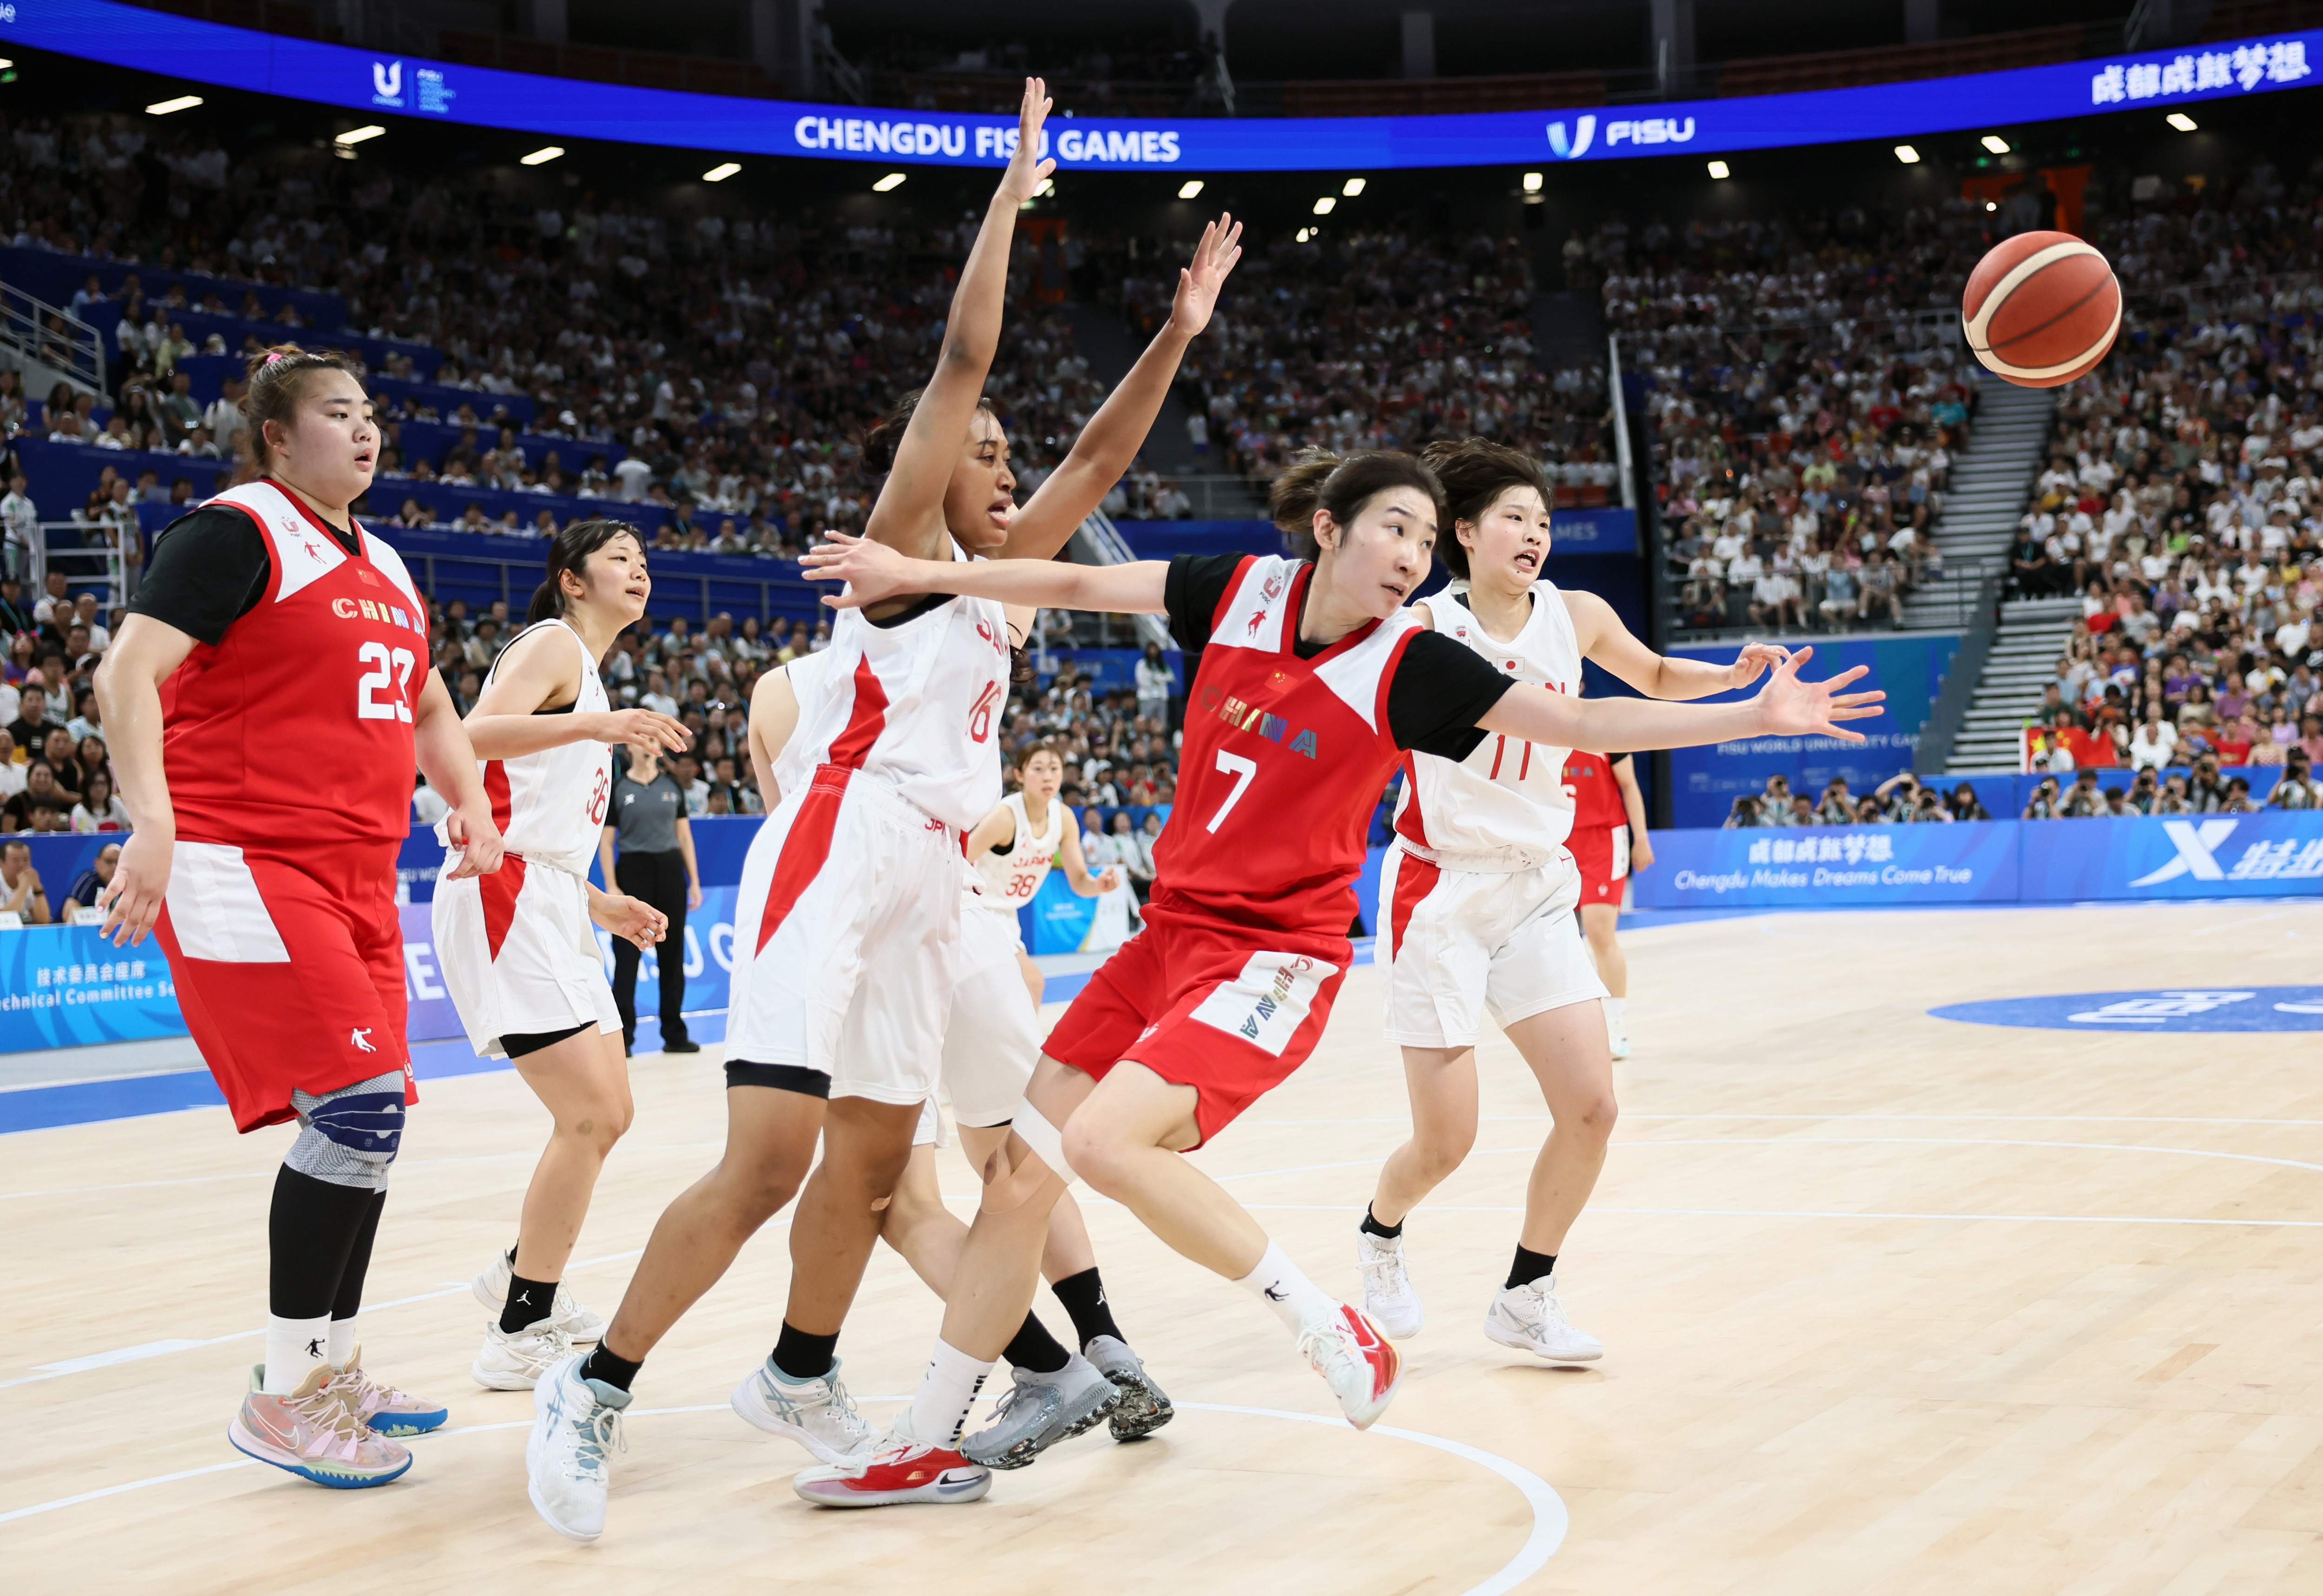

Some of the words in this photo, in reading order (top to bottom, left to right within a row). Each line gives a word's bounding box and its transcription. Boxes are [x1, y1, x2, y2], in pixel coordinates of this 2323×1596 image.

[794, 116, 966, 157] CHENGDU
[1057, 130, 1181, 162] GAMES
[1606, 117, 1695, 146] FISU
[332, 598, 426, 639] CHINA
[1259, 591, 1271, 604] FUSC
[358, 641, 415, 723] 23
[966, 680, 1001, 744] 16
[1201, 684, 1317, 759] CHINA
[1490, 734, 1531, 781] 11
[1750, 738, 1803, 754] WORLD
[586, 767, 608, 825] 36
[1206, 749, 1257, 834] 7
[1006, 874, 1037, 897] 38
[1674, 869, 1749, 894] Chengdu
[1751, 868, 1809, 889] Makes
[1813, 867, 1879, 887] Dreams
[1881, 865, 1933, 885] Come
[1933, 865, 1973, 884] True
[37, 960, 146, 988] 技术委员会座席
[65, 983, 154, 1005] Committee
[1240, 955, 1313, 1040] CHINA
